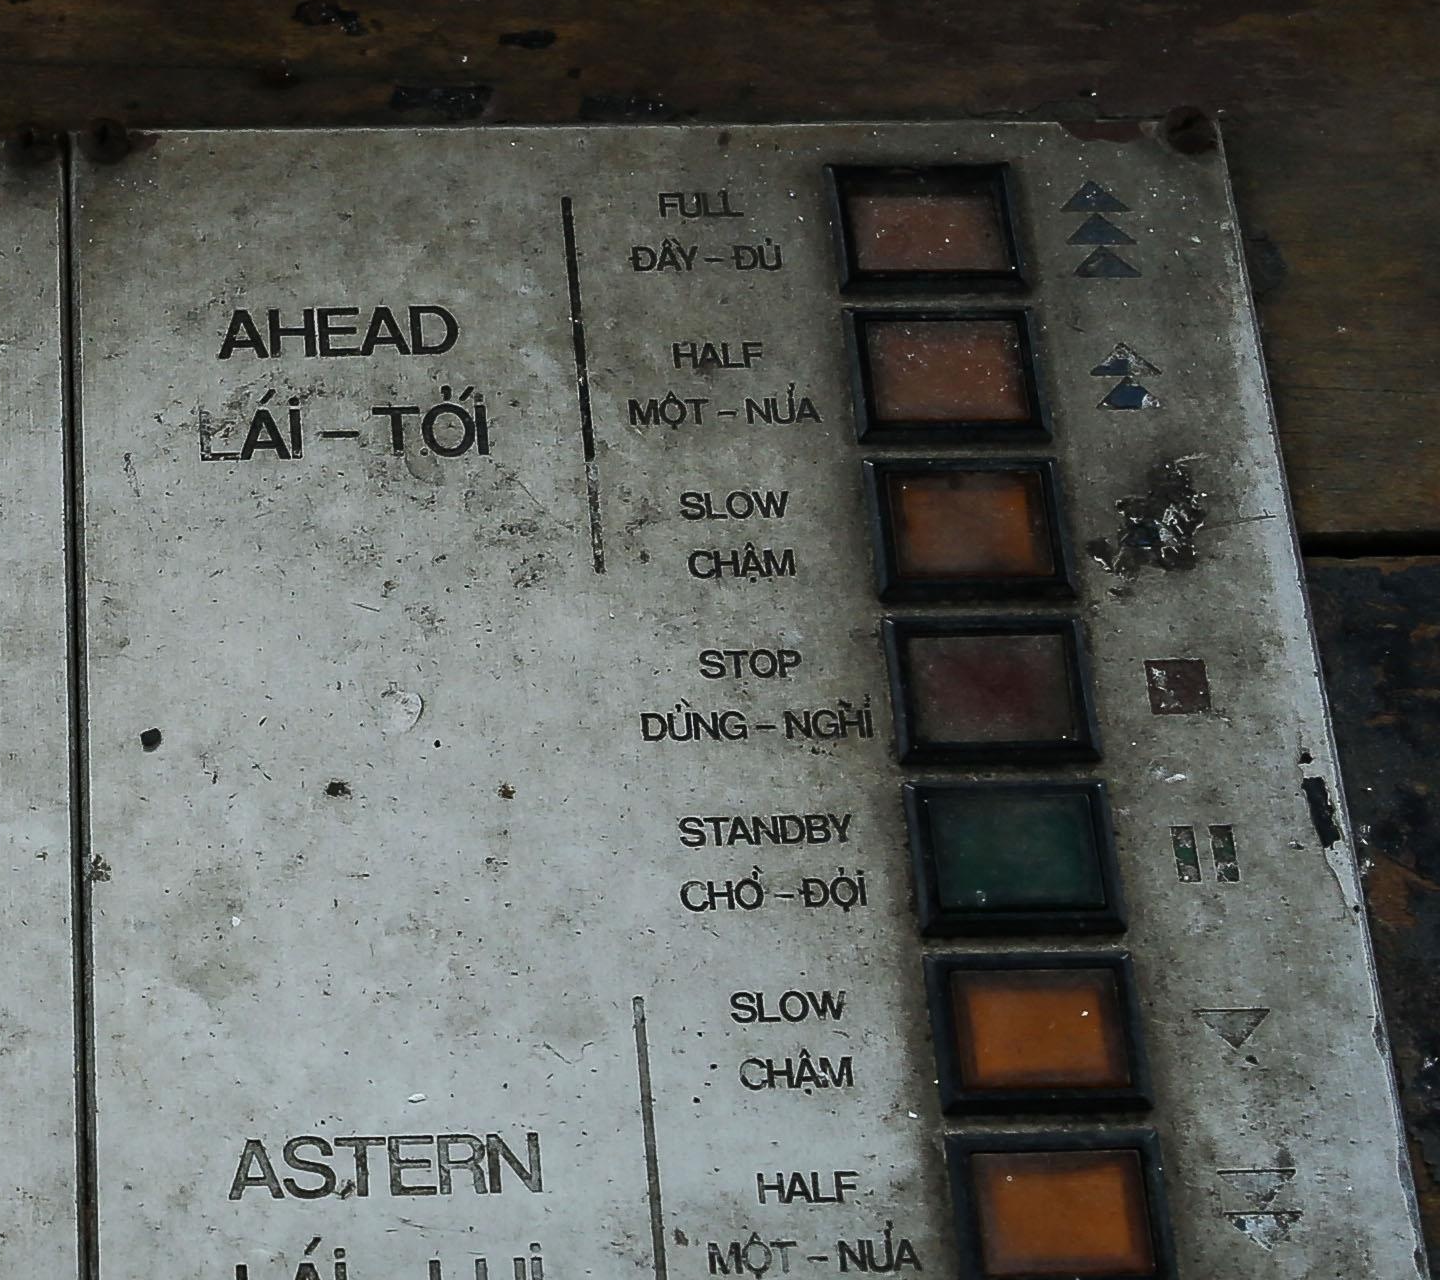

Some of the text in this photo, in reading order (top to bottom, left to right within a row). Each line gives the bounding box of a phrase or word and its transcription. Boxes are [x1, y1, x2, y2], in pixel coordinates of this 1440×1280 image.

[658, 190, 744, 218] FULL
[218, 304, 459, 359] AHEAD
[672, 341, 763, 369] HALF
[679, 490, 789, 521] SLOW
[687, 541, 797, 583] CHẬM
[698, 648, 803, 680] STOP
[678, 813, 852, 848] STANDBY
[730, 990, 846, 1023] SLOW
[739, 1048, 855, 1095] CHẬM
[228, 1131, 543, 1201] ASTERN
[756, 1171, 859, 1204] HALF
